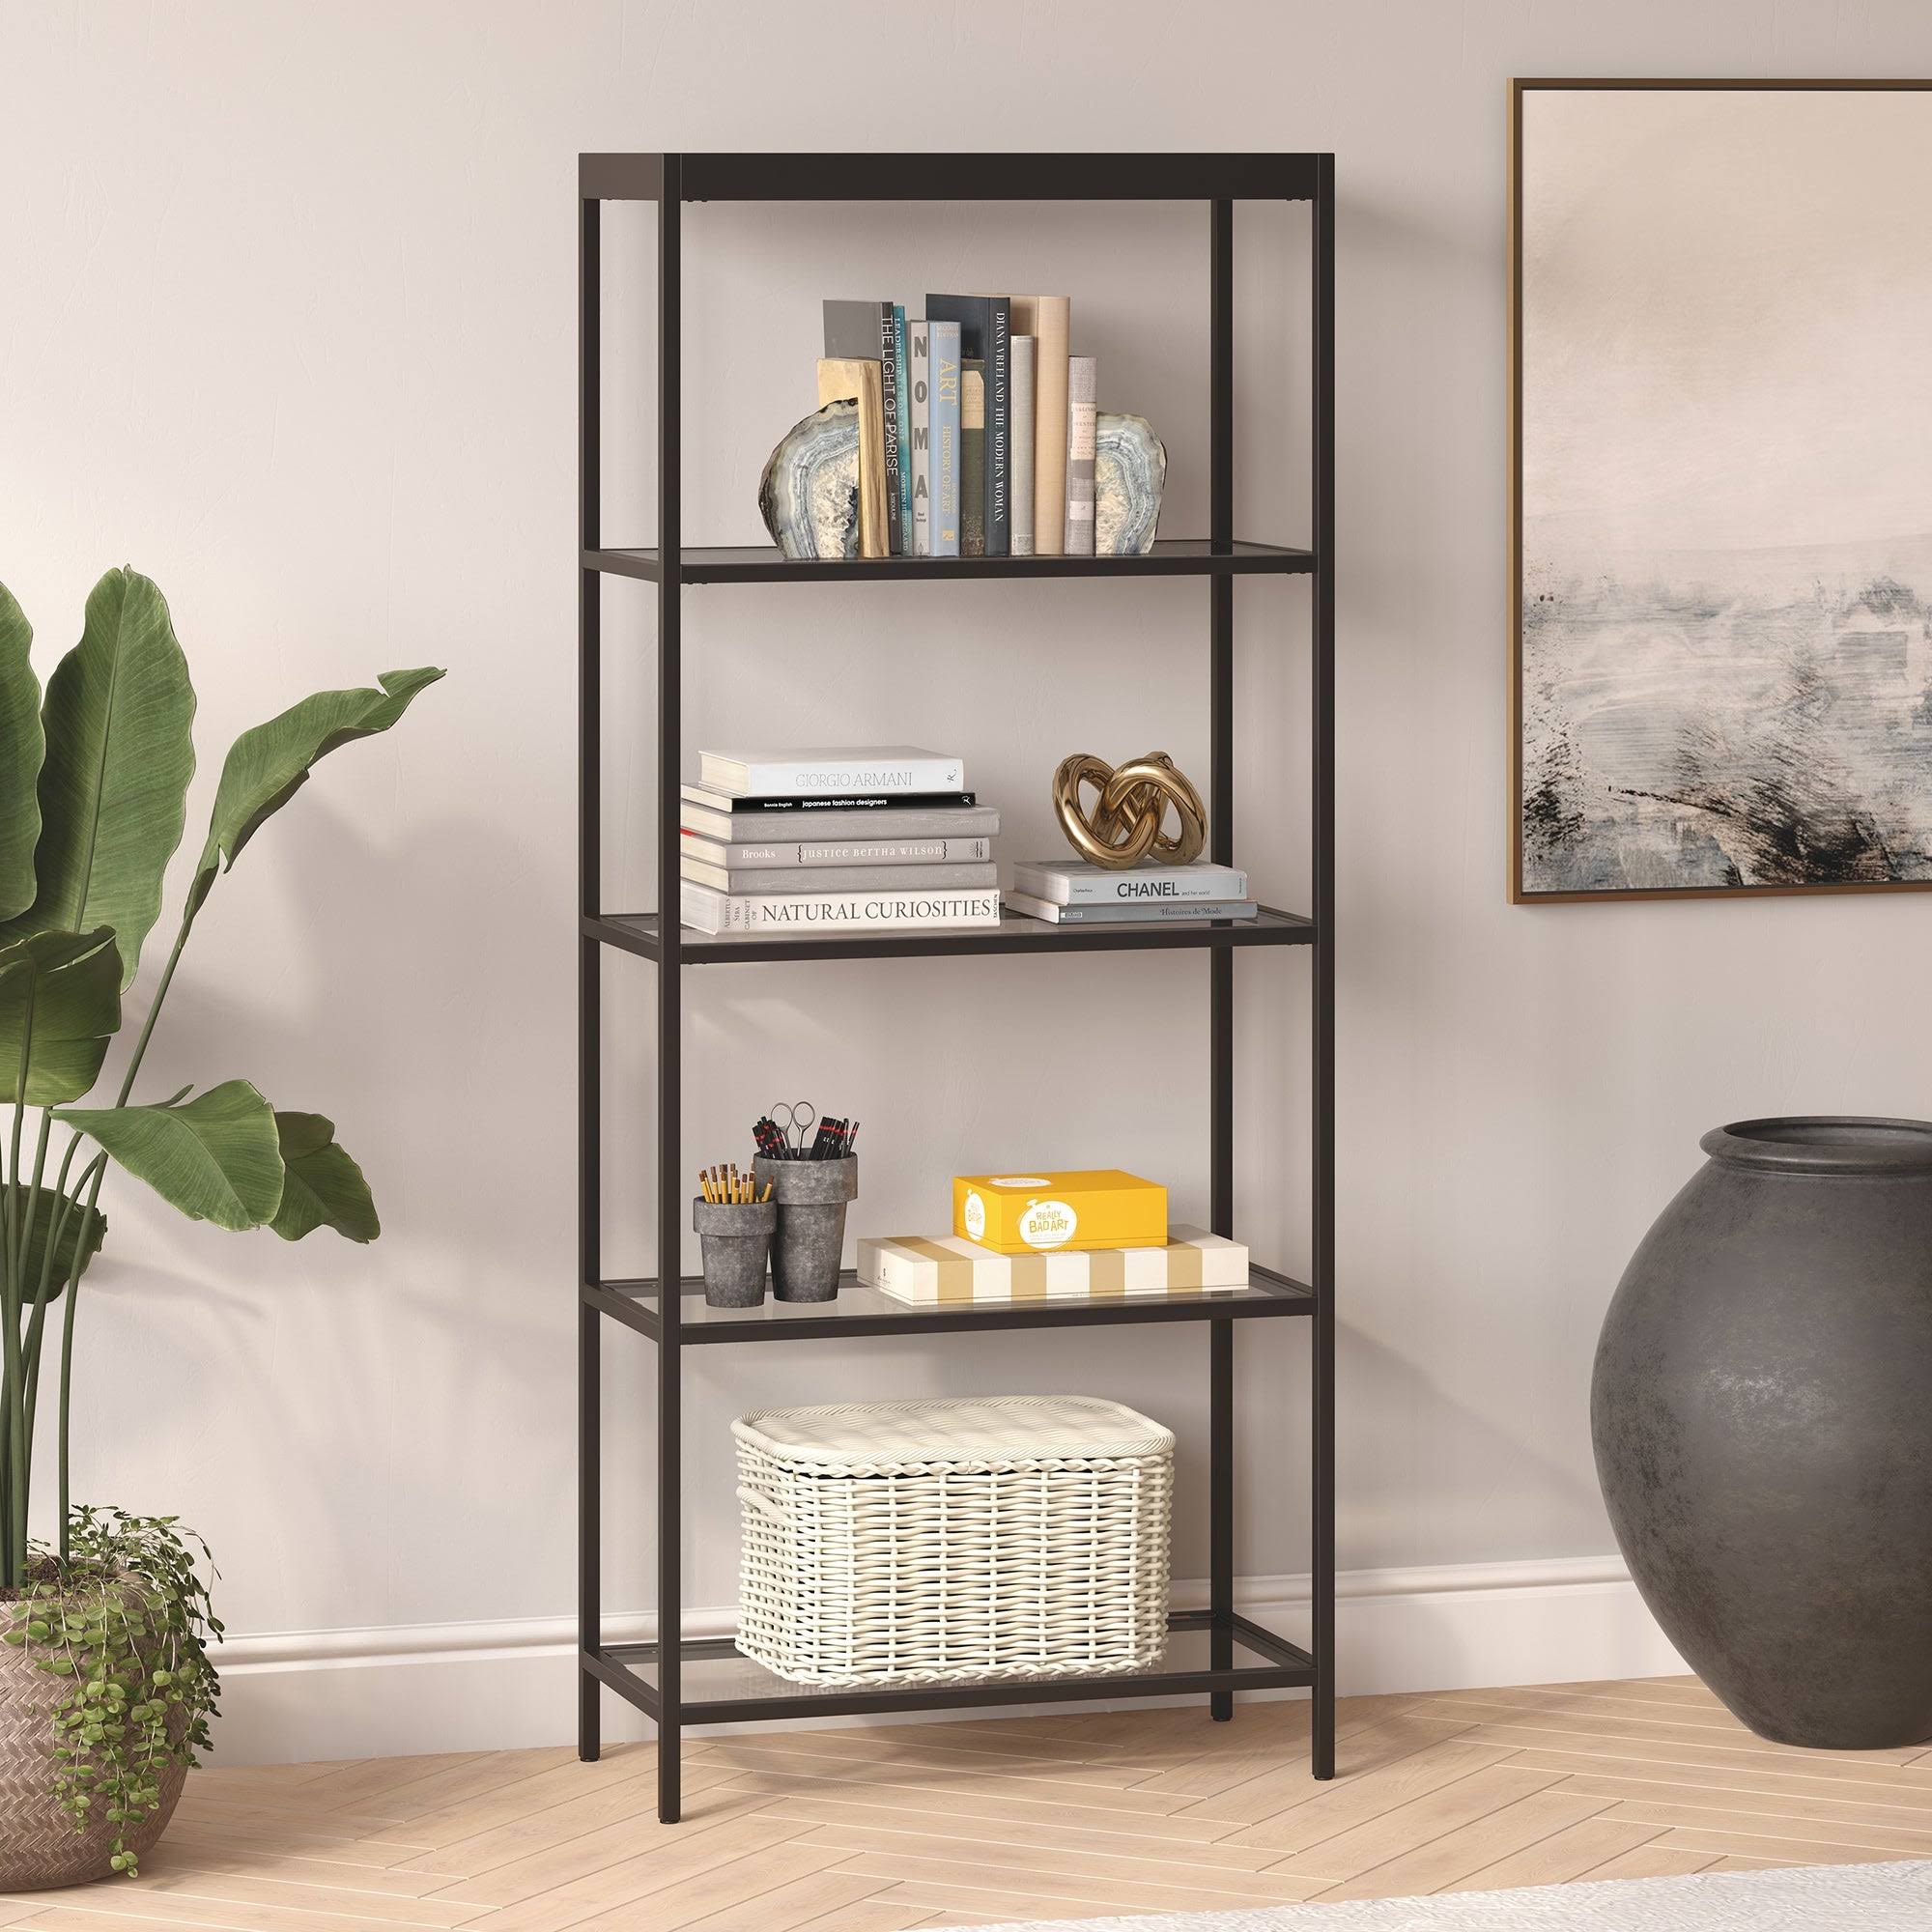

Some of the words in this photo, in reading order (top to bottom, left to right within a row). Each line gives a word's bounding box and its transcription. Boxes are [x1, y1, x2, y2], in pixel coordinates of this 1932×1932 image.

[881, 315, 894, 345] THE
[995, 312, 1006, 345] DIANA
[882, 349, 895, 395] LIGHT
[939, 357, 958, 406] ART
[995, 348, 1005, 403] VREELAND
[884, 398, 896, 422] OF
[995, 406, 1005, 429] THE
[885, 424, 898, 477] PARISE
[942, 425, 952, 472] HISTORY
[994, 432, 1004, 478] MODERN
[994, 480, 1004, 522] WOMAN
[795, 772, 851, 787] GIORGIO
[852, 772, 913, 786] ARMANI
[856, 798, 888, 808] designers
[742, 849, 777, 859] Brooks
[1117, 881, 1179, 898] CHANEL
[761, 902, 861, 922] NATURAL
[865, 898, 991, 920] CURIOSITIES
[1029, 1220, 1050, 1234] BAD
[1050, 1218, 1069, 1232] ART
[1036, 1209, 1062, 1221] REALLY
